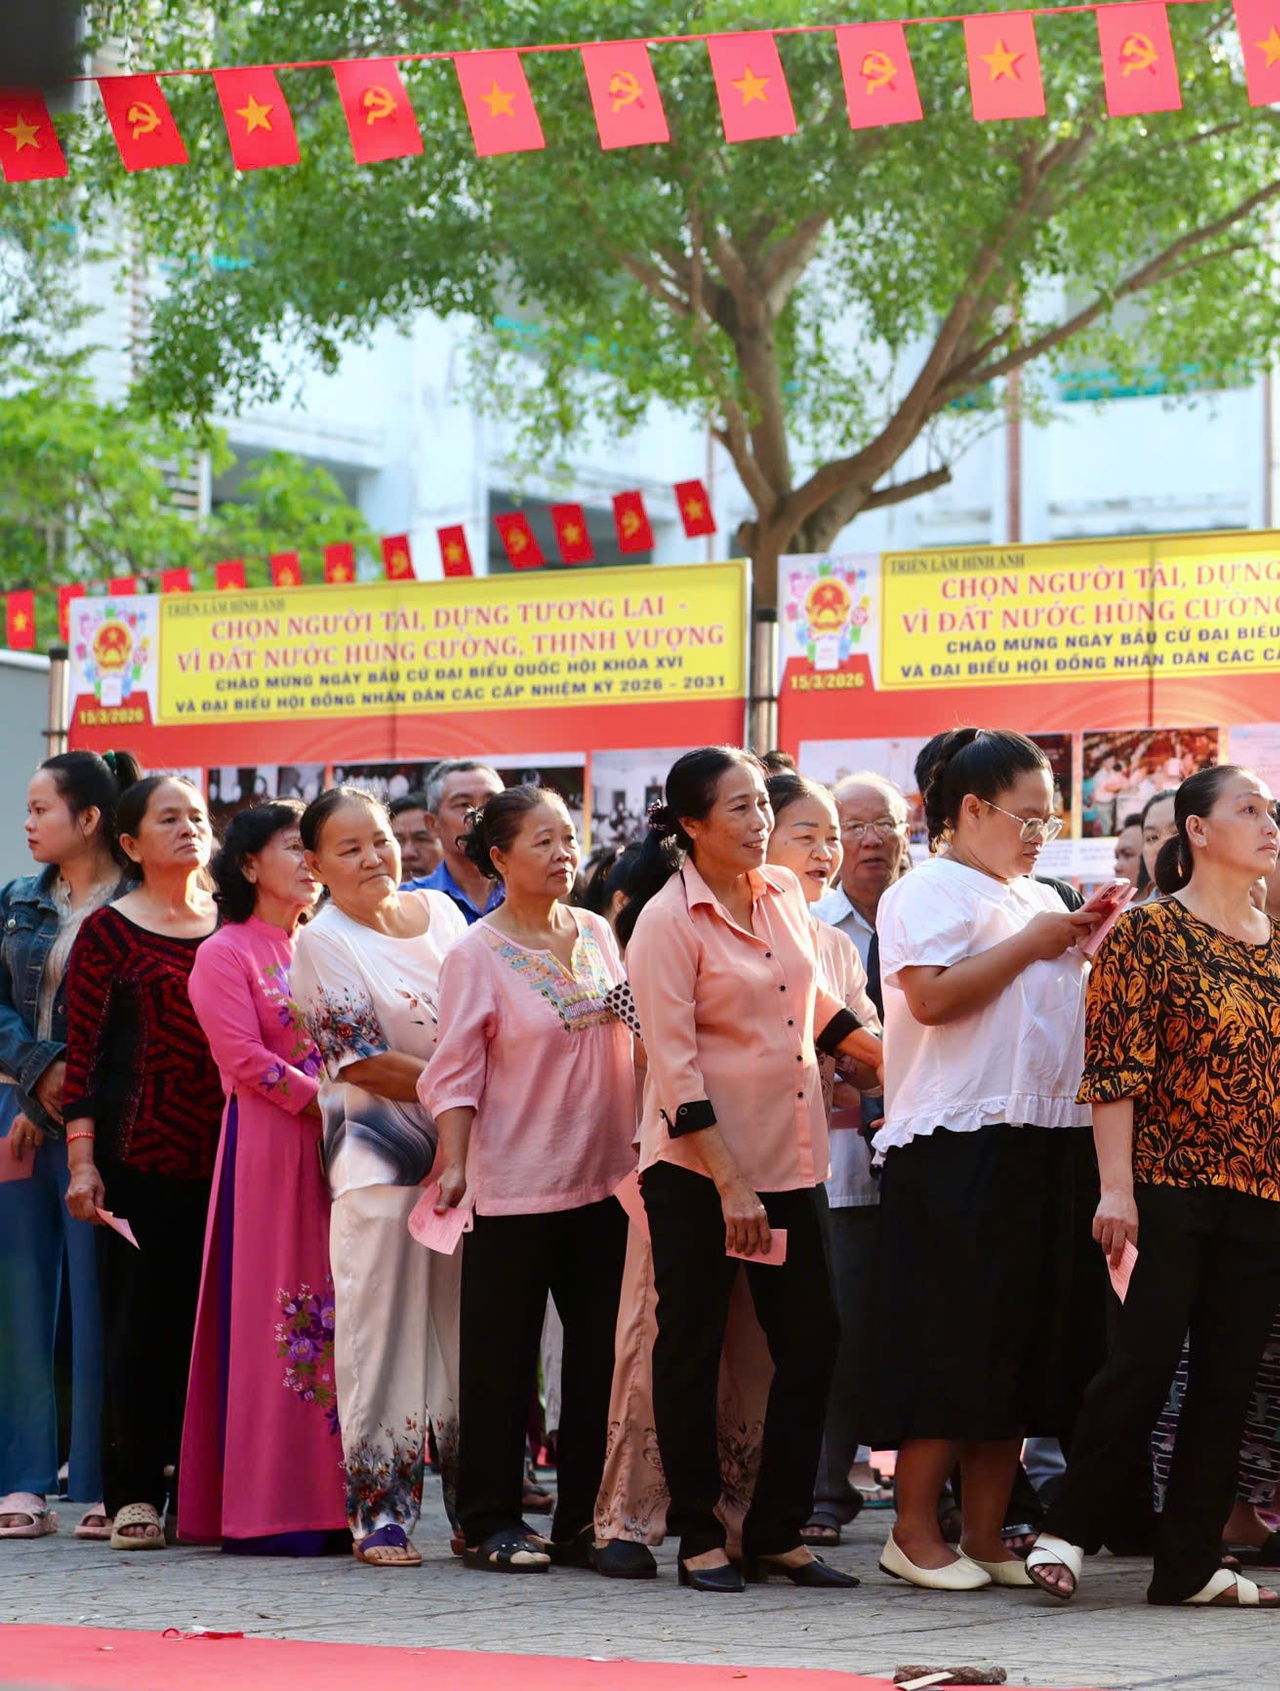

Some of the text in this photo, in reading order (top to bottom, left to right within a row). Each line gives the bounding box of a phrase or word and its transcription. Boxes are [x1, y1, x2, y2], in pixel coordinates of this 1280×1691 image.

[940, 574, 1019, 603] CHỌN
[1027, 563, 1125, 594] NGƯỜI
[1133, 560, 1188, 590] TÀI,
[211, 617, 280, 643] CHỌN
[287, 607, 372, 636] NGƯỜI
[379, 604, 427, 633] TÀI,
[433, 604, 510, 632] DỰNG
[516, 598, 615, 624] TƯƠNG
[623, 595, 665, 618] LAI
[901, 607, 929, 634] VÌ
[938, 603, 994, 633] ĐẤT
[1001, 600, 1086, 630] NƯỚC
[1094, 597, 1176, 625] HÙNG
[177, 624, 724, 673] VÌ ĐẤT NƯỚC HÙNG CƯỜNG, THỊNH VƯỢNG
[655, 656, 683, 670] XVI
[620, 678, 663, 693] 2026
[682, 674, 725, 689] 2031
[790, 673, 865, 691] 15/3/2026
[78, 708, 144, 726] 15/3/2026
